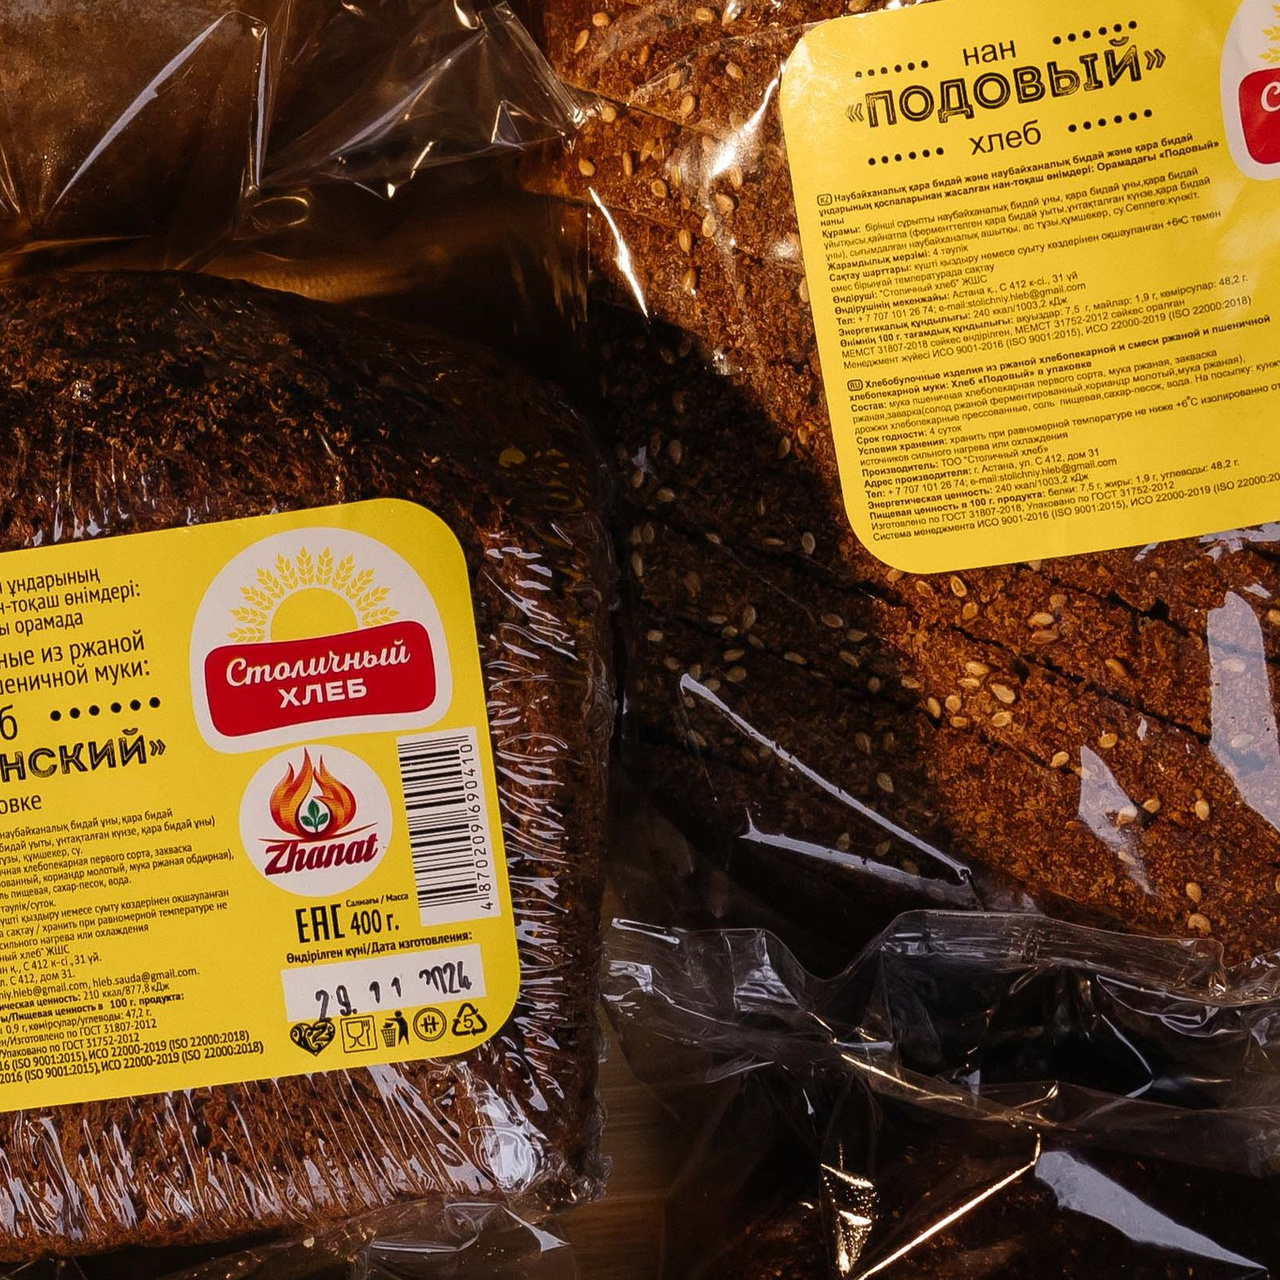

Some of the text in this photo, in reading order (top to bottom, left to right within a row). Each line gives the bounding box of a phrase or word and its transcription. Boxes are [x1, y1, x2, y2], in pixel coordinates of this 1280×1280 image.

[961, 38, 1017, 68] нан
[843, 34, 1167, 129] «ПОДОВЫЙ»
[967, 117, 1042, 157] хлеб
[863, 355, 1038, 389] Хлебобулочные изделия из ржаной
[871, 529, 913, 543] Система
[912, 521, 976, 537] менеджмента
[975, 516, 1000, 529] ИСО
[5, 566, 102, 598] ұндарының
[63, 578, 142, 607] өнімдері:
[13, 610, 85, 638] орамада
[39, 644, 64, 665] из
[68, 627, 145, 665] ржаной
[93, 658, 151, 687] муки:
[224, 638, 411, 687] Столичный
[277, 676, 367, 709] ХЛЕБ
[263, 829, 378, 876] Zhanat
[349, 907, 401, 937] 400 г.
